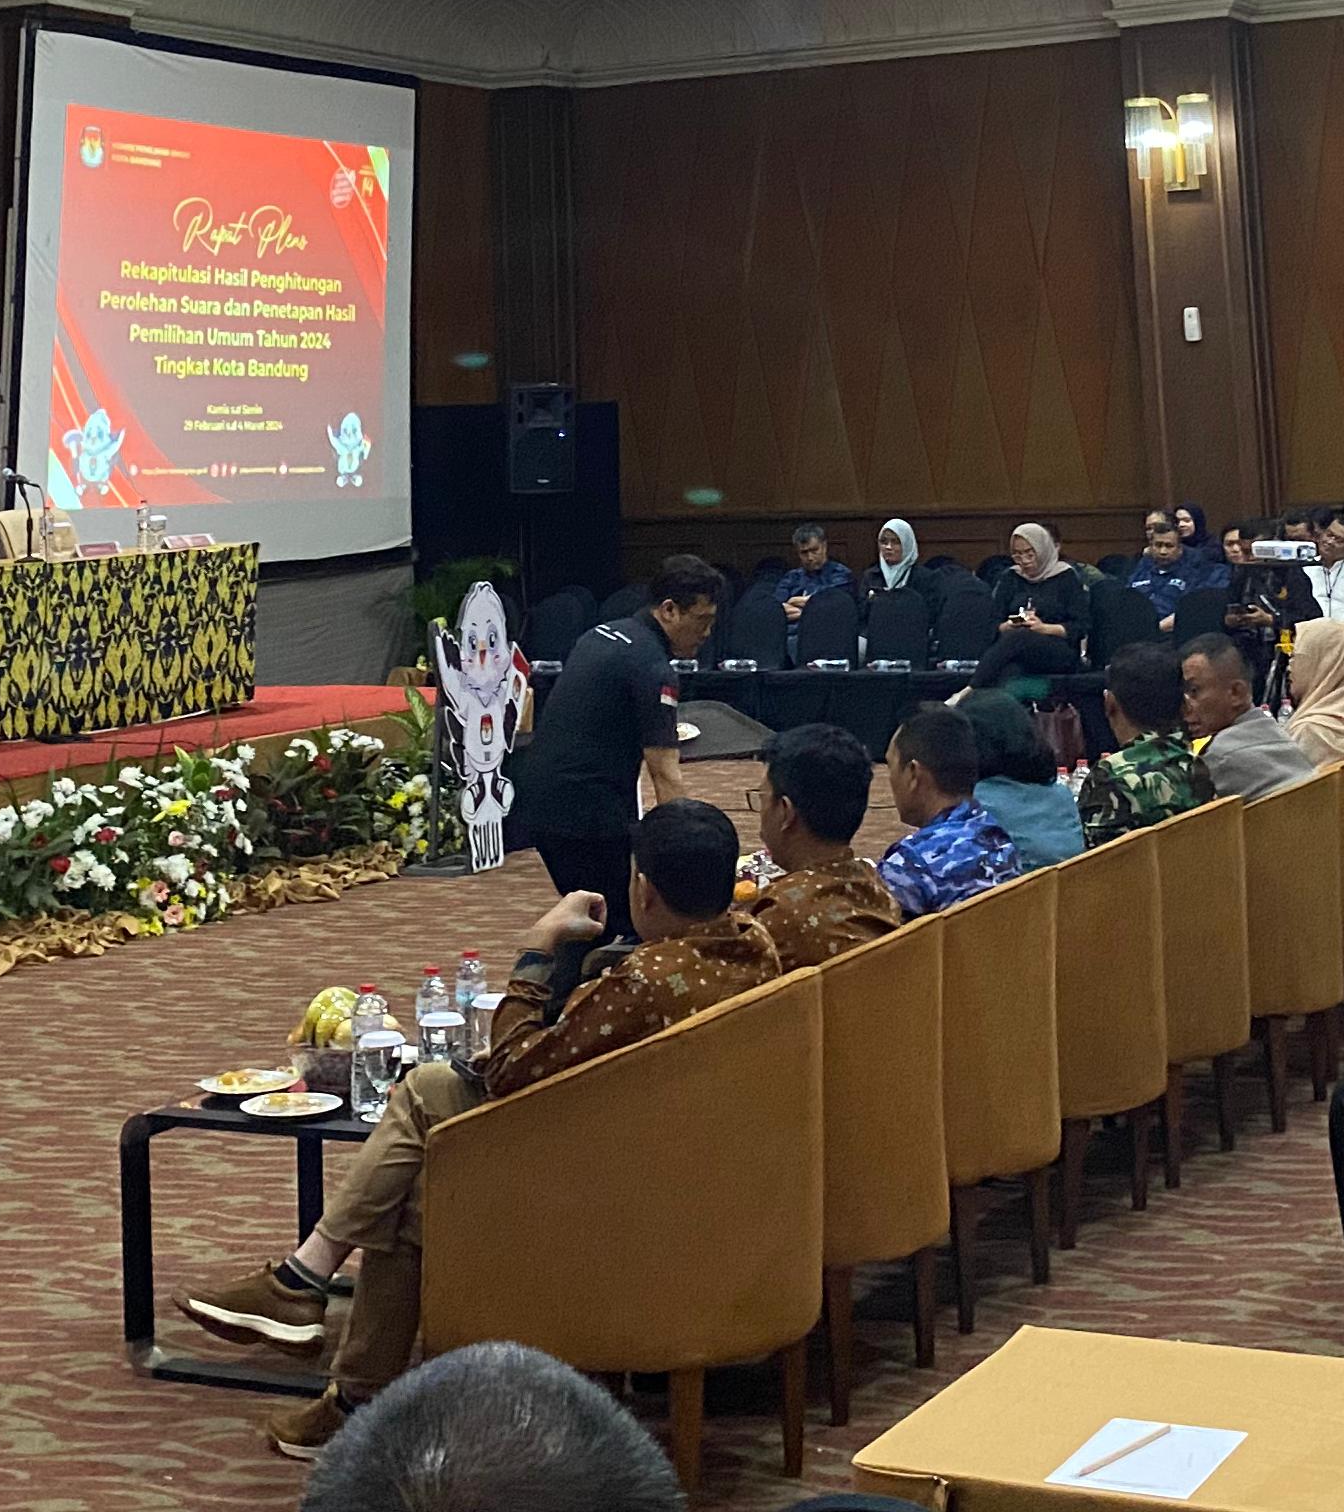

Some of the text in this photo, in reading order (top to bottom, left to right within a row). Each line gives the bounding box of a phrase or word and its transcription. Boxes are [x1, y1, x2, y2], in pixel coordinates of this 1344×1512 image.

[120, 260, 343, 296] Rekapitulasi Hasil Penghitungan
[100, 290, 356, 323] Perolehan Suara dan Penetapan Hasil
[129, 323, 332, 350] Pemilihan Umum Tahun 2024
[154, 355, 309, 382] Tingkat Kota Bandung
[473, 820, 500, 869] SULU
